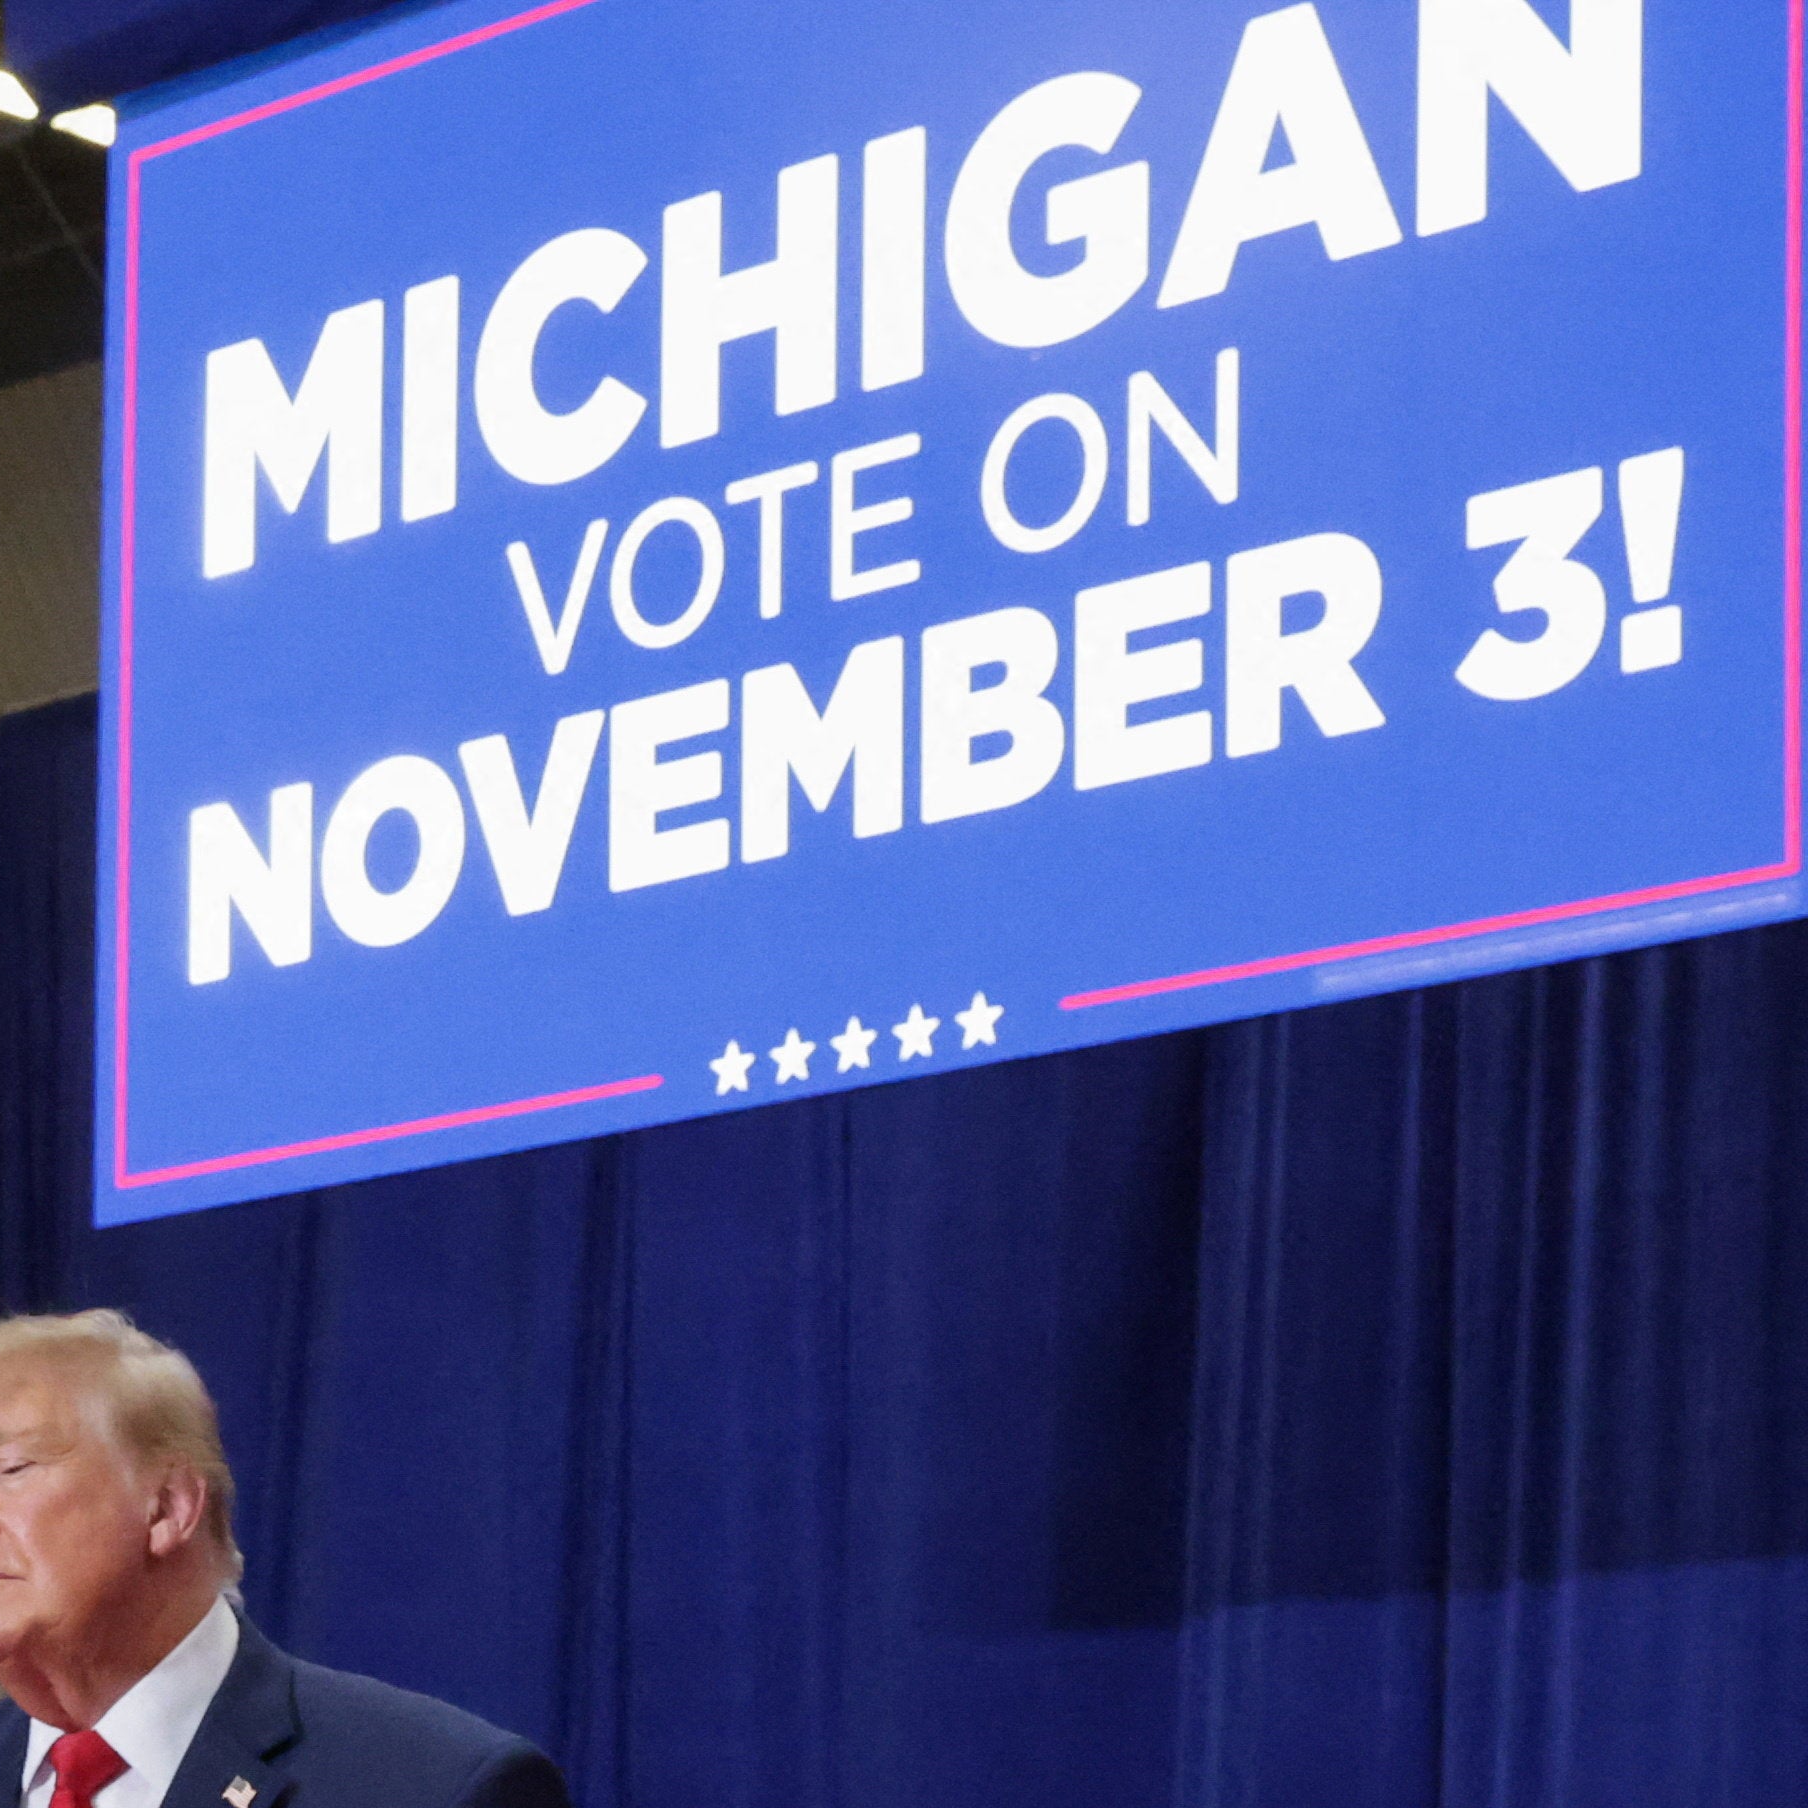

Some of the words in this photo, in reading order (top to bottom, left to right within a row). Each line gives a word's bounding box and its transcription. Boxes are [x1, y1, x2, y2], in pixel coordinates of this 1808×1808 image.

[200, 0, 1645, 582] MICHIGAN
[504, 431, 923, 677] VOTE
[978, 346, 1241, 556] ON
[185, 530, 1388, 988] NOVEMBER
[1452, 446, 1686, 703] 3!
